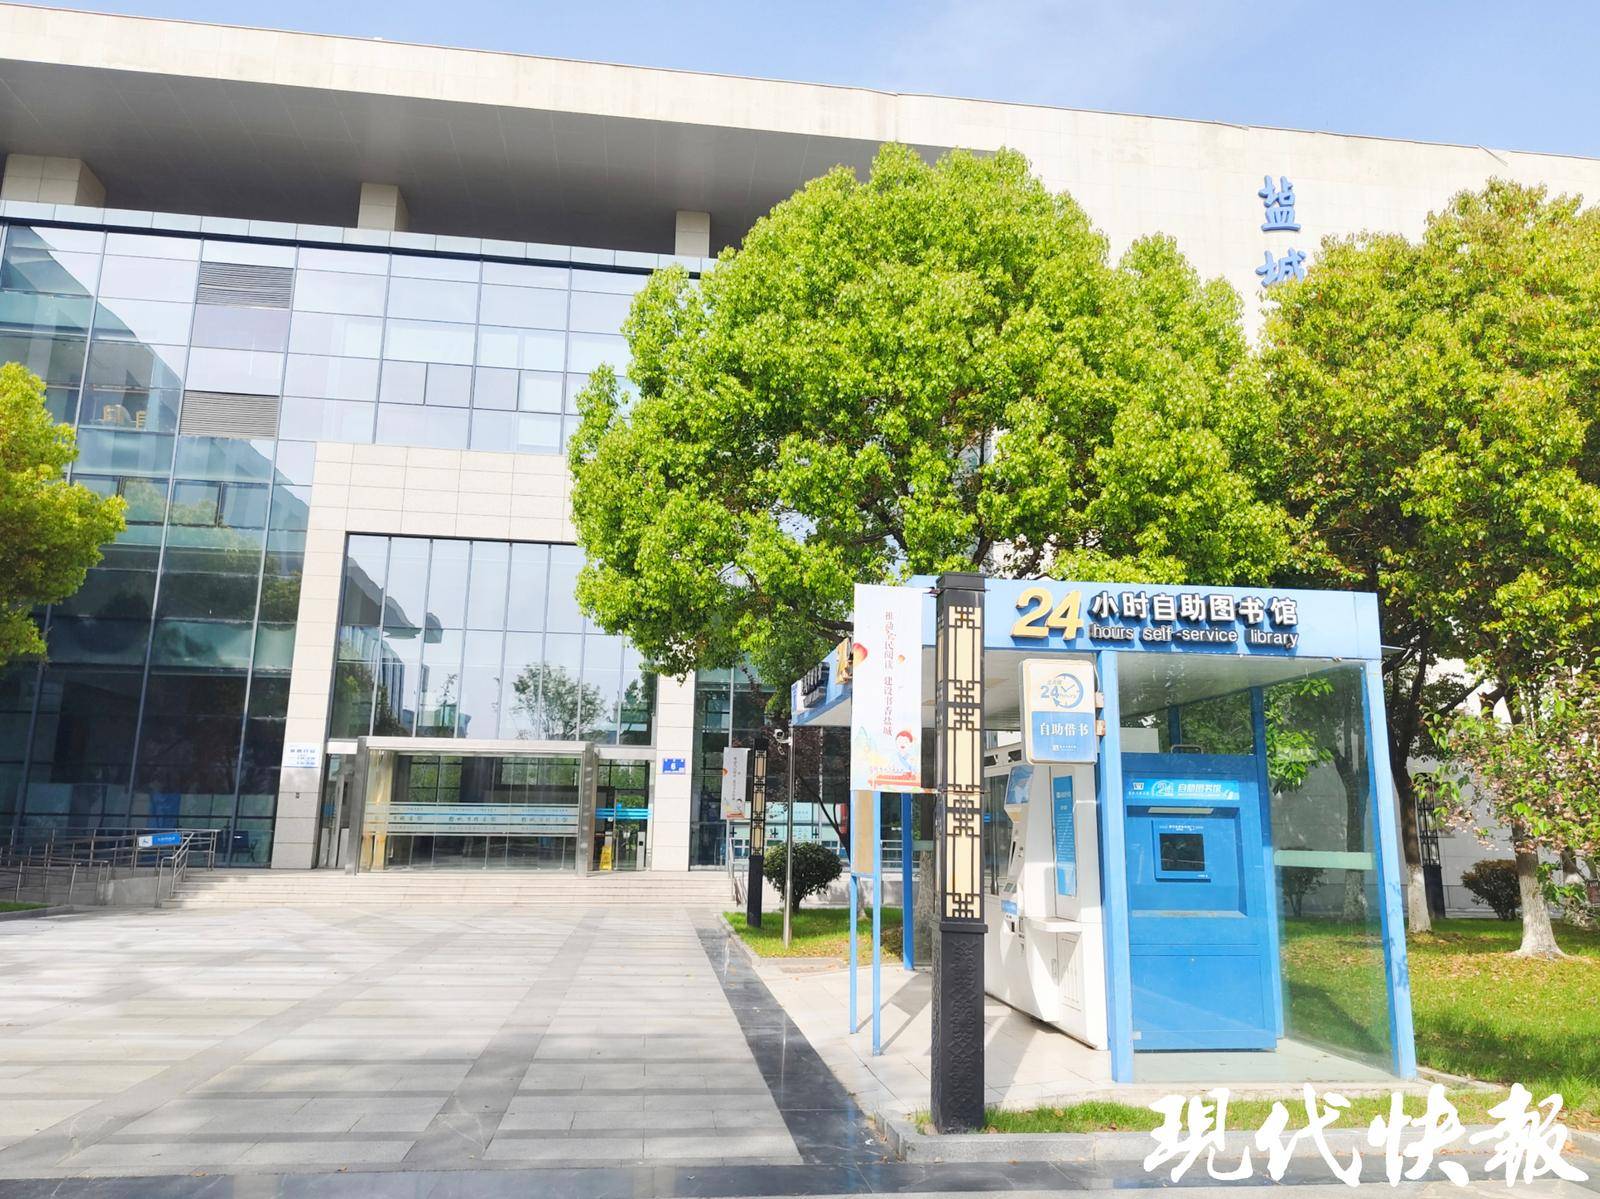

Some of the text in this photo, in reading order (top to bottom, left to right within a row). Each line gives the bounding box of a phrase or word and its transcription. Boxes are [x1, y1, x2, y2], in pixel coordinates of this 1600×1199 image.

[1009, 587, 1299, 641] 24 小时自助图书馆
[1091, 624, 1135, 641] hours
[1250, 629, 1299, 649] library
[1040, 722, 1089, 737] 自助借书
